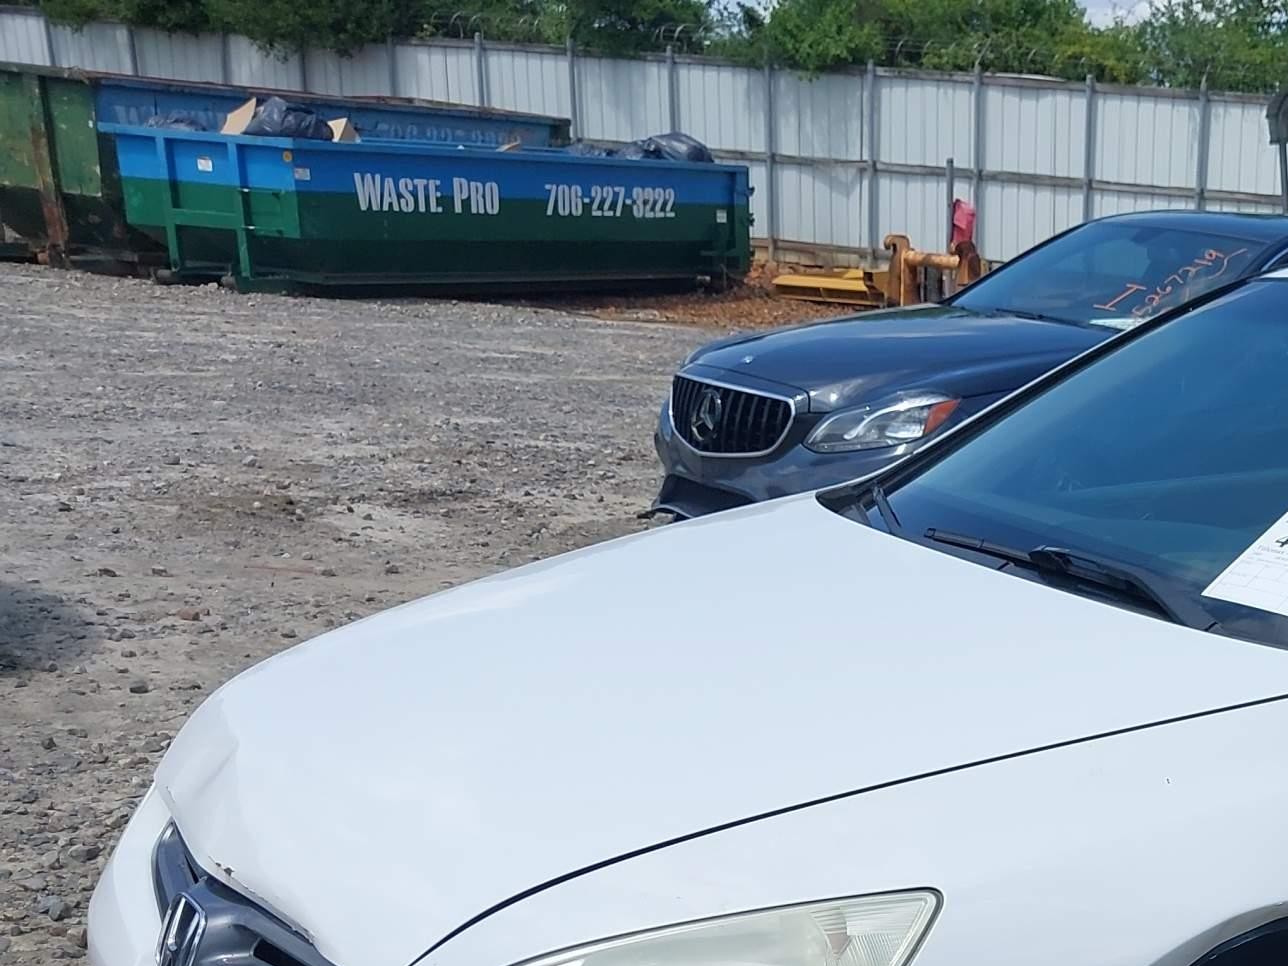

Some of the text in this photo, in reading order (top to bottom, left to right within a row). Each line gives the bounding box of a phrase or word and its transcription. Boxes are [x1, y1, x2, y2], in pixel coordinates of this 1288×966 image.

[353, 172, 500, 216] WASTE PRO
[544, 184, 676, 219] 706-227-3222
